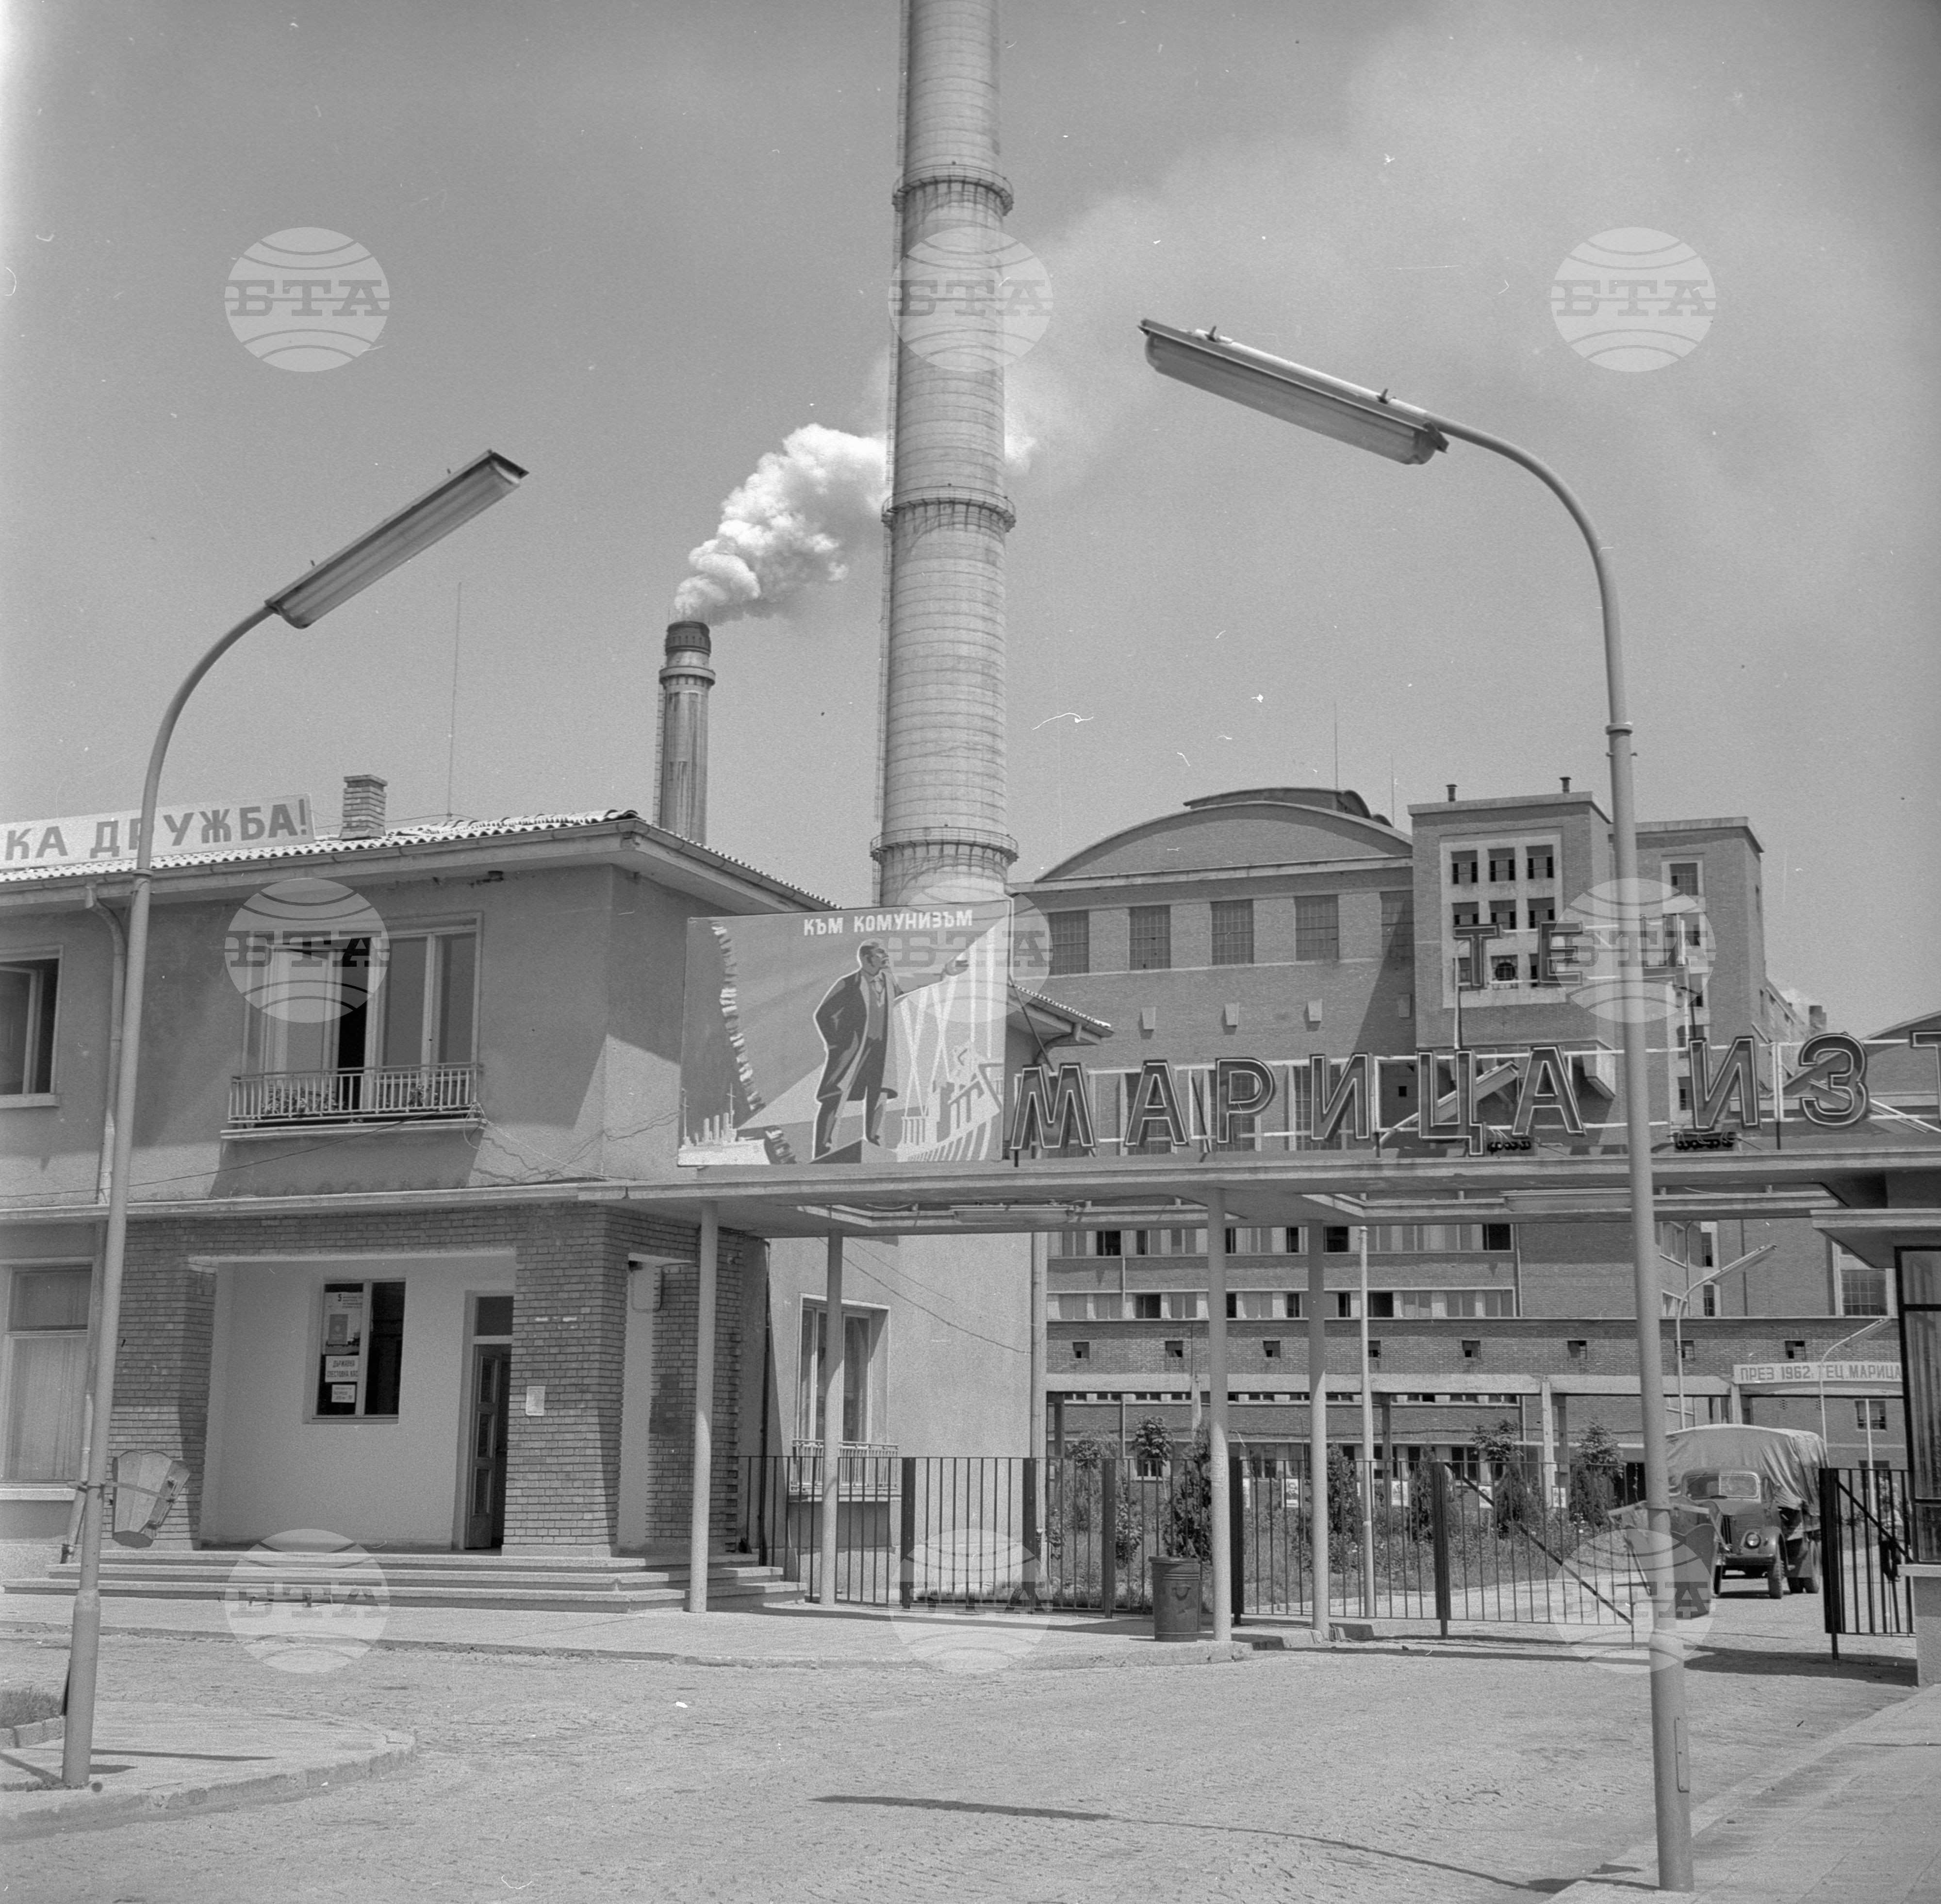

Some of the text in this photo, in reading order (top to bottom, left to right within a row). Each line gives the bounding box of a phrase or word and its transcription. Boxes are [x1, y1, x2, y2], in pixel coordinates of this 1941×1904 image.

[5, 826, 68, 861] КА
[804, 910, 972, 936] КЪМ КОМУНИЗЪМ
[1010, 1045, 1587, 1156] МАРИЦА
[1740, 1367, 1774, 1381] ПРЕЗ
